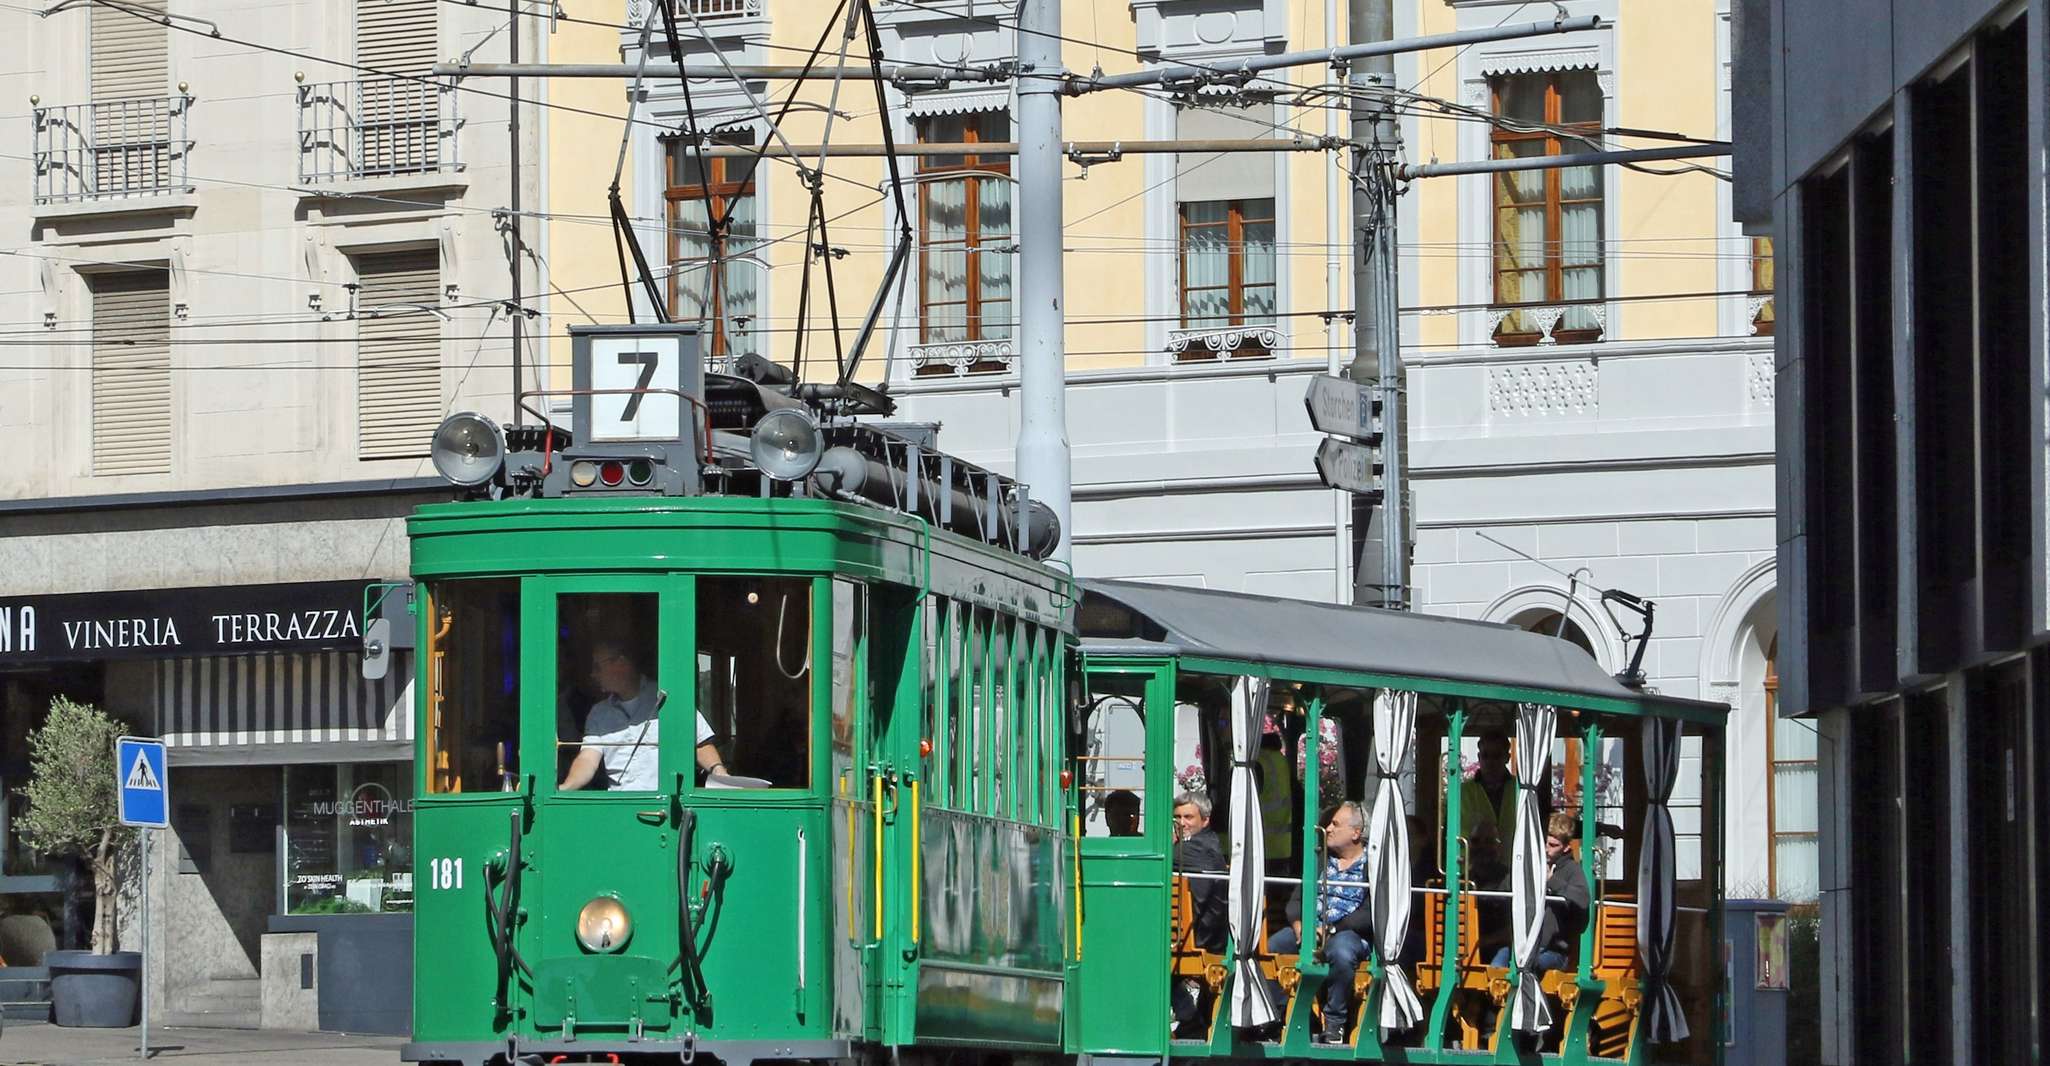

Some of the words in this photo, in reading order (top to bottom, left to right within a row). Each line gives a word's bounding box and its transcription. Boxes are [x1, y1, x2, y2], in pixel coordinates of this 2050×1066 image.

[617, 352, 658, 422] 7
[63, 617, 181, 649] VINERIA
[212, 609, 359, 644] TERRAZZA
[430, 857, 463, 889] 181
